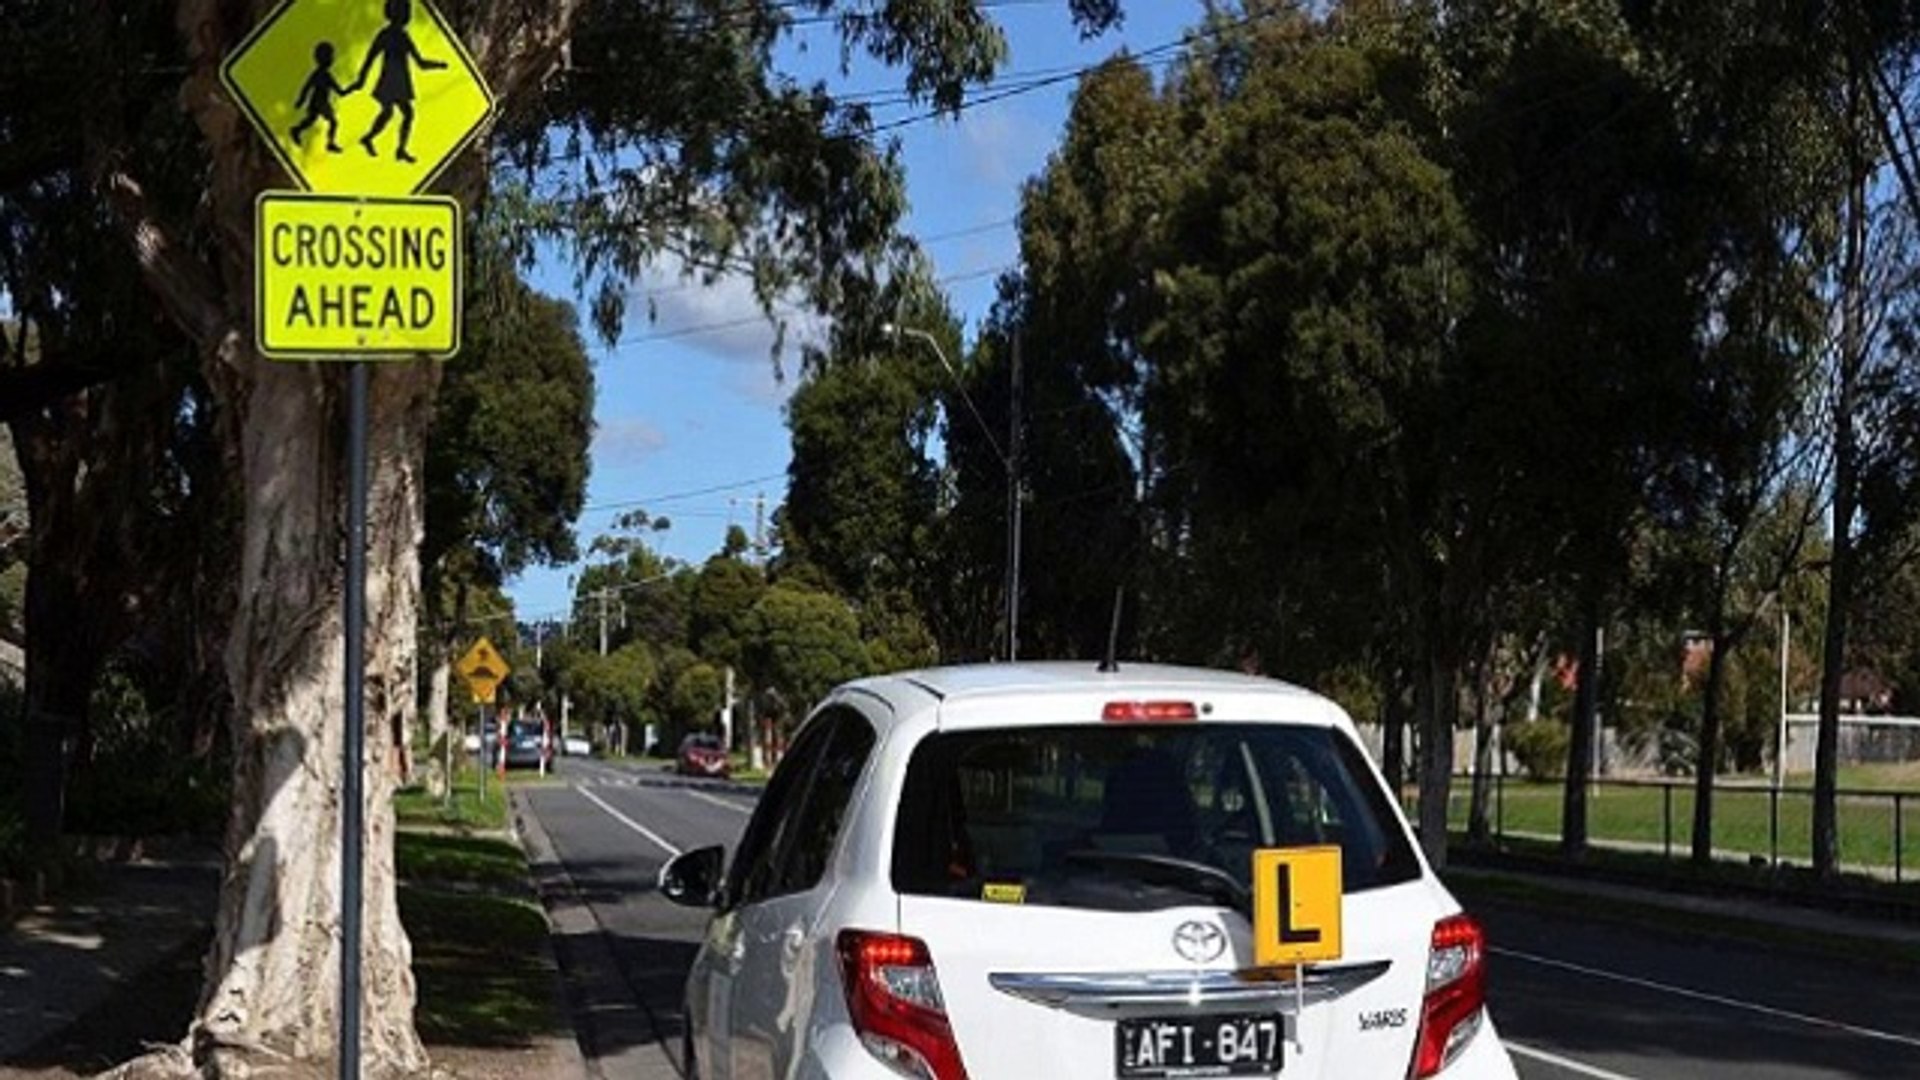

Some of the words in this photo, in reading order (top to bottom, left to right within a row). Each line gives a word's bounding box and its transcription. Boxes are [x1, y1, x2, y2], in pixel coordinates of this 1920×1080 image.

[272, 222, 446, 271] CROSSING
[286, 285, 435, 329] AHEAD
[1277, 863, 1321, 944] L
